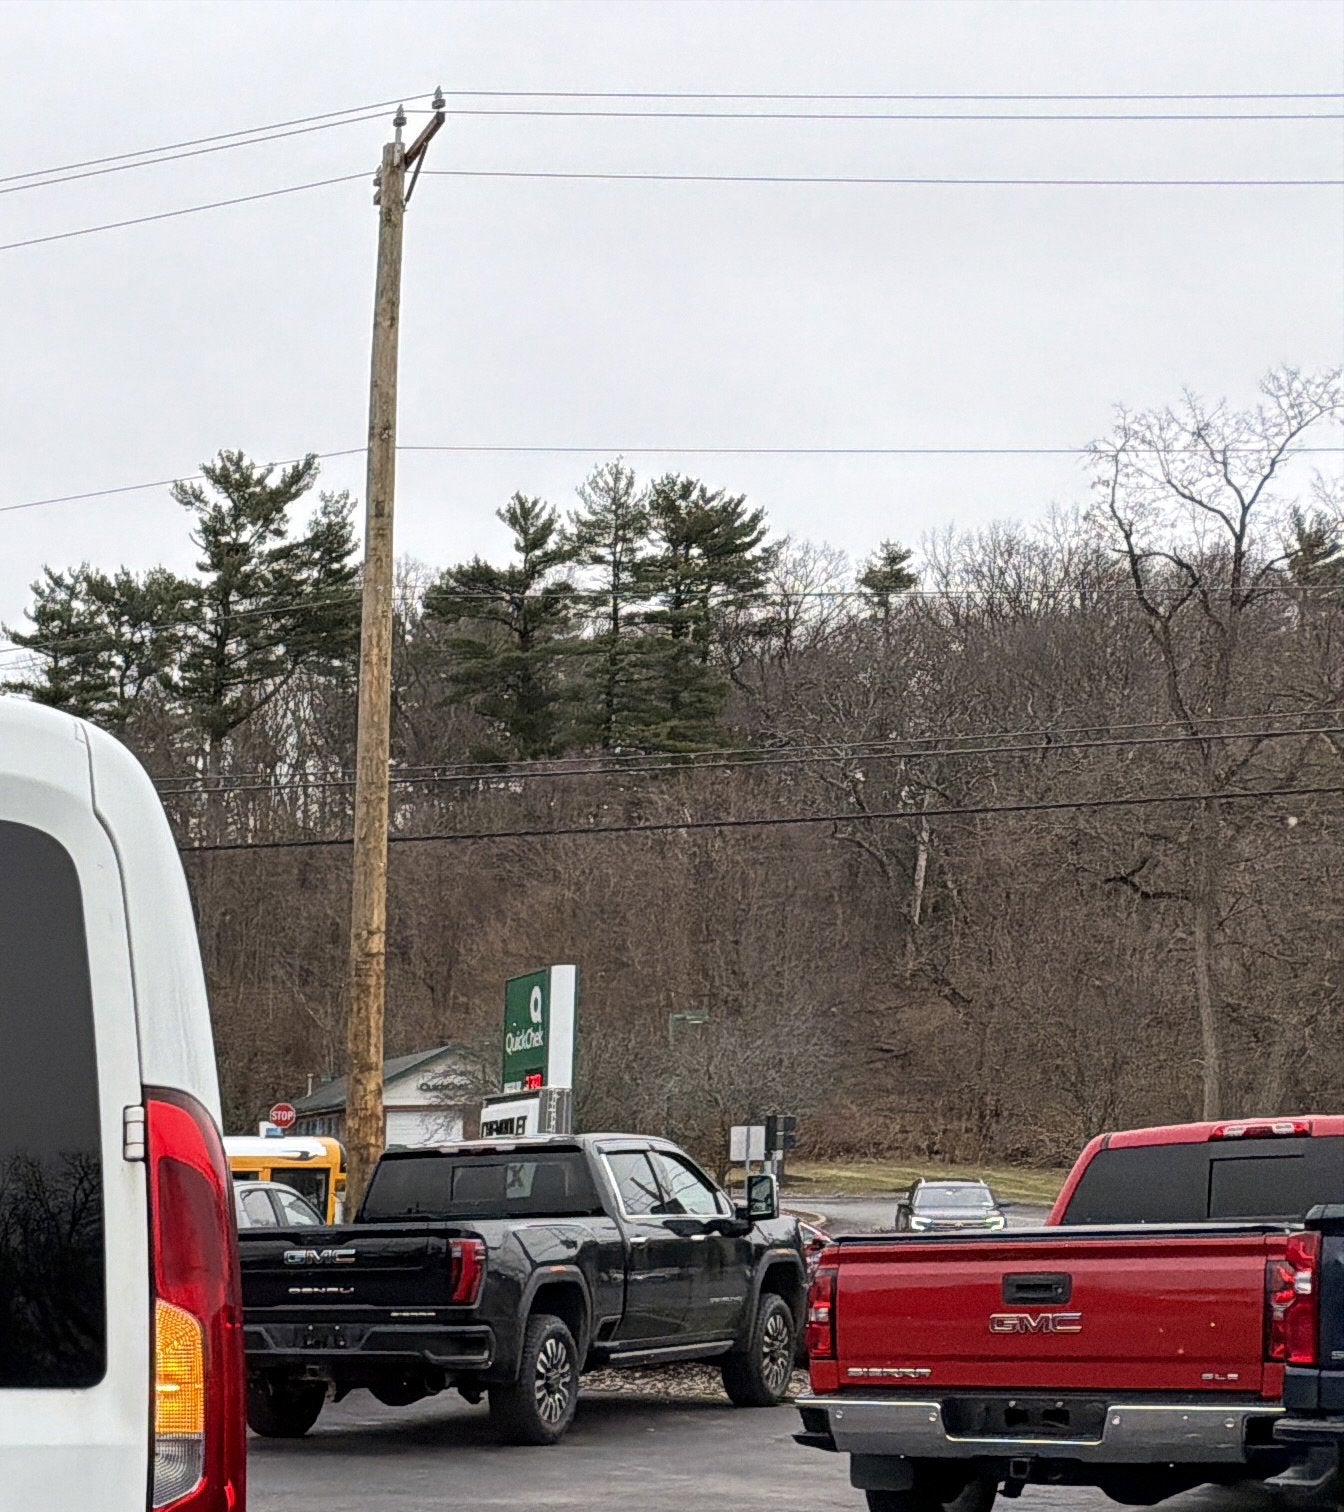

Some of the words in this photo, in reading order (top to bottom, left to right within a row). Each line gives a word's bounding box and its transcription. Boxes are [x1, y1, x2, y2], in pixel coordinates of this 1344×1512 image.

[505, 1026, 544, 1055] QuickChek
[272, 1110, 294, 1121] STOP
[284, 1249, 356, 1265] GMC
[989, 1312, 1083, 1334] GMC
[847, 1367, 932, 1379] SIERRA
